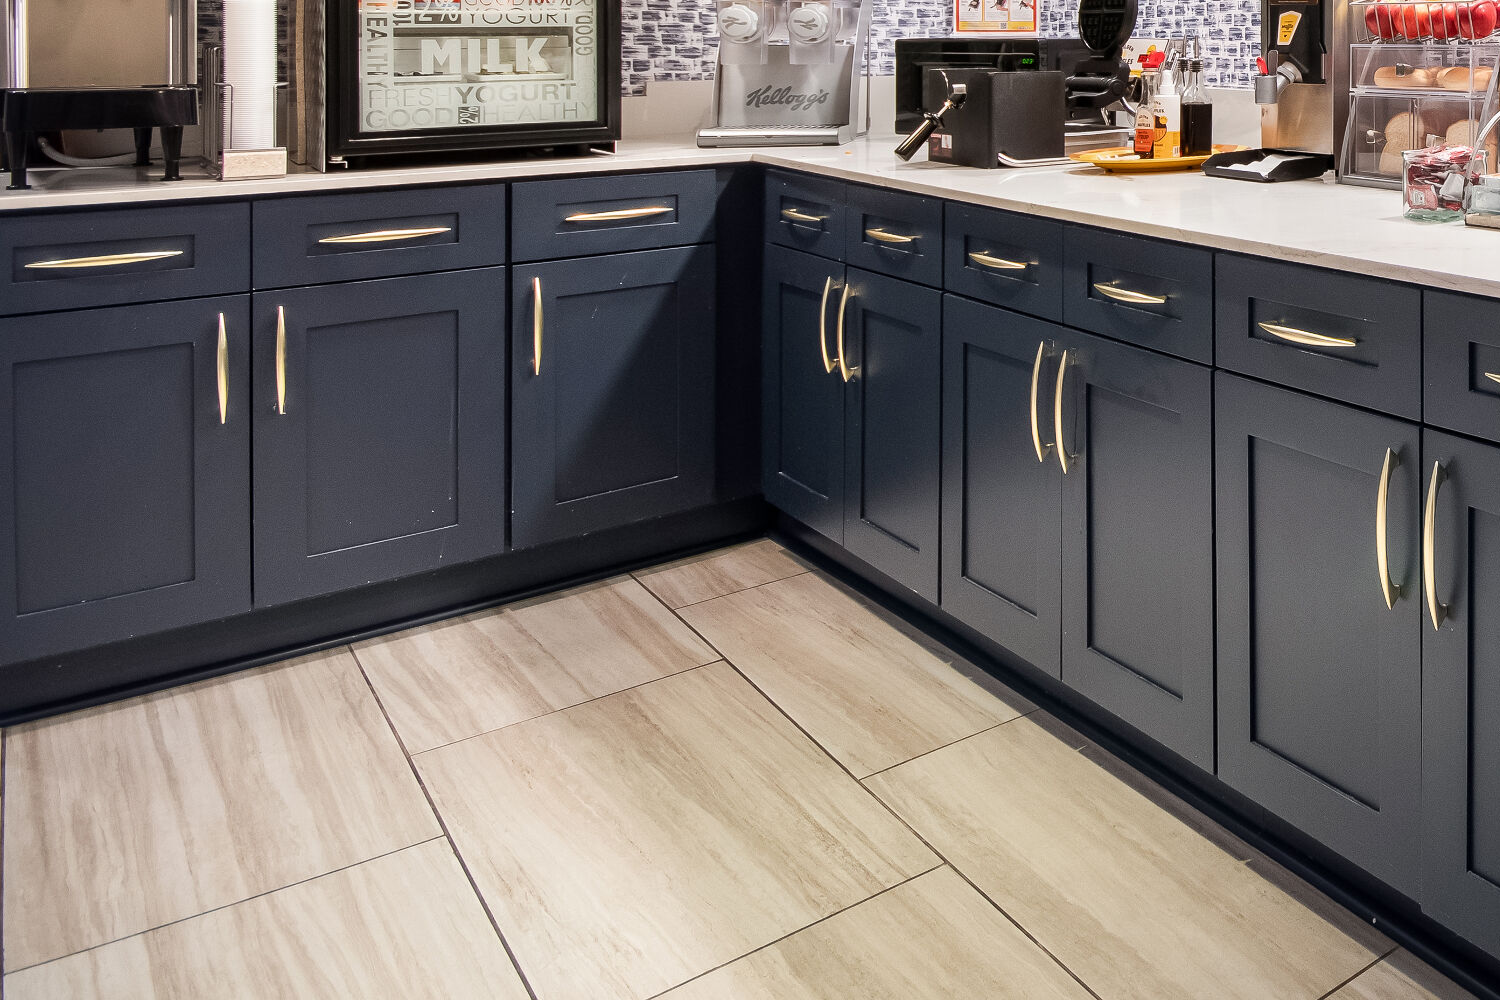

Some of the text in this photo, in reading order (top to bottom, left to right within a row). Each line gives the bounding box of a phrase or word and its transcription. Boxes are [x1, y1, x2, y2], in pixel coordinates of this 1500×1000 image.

[421, 38, 548, 74] MILK
[455, 83, 577, 105] YOGURT
[745, 84, 830, 111] Kellogg's
